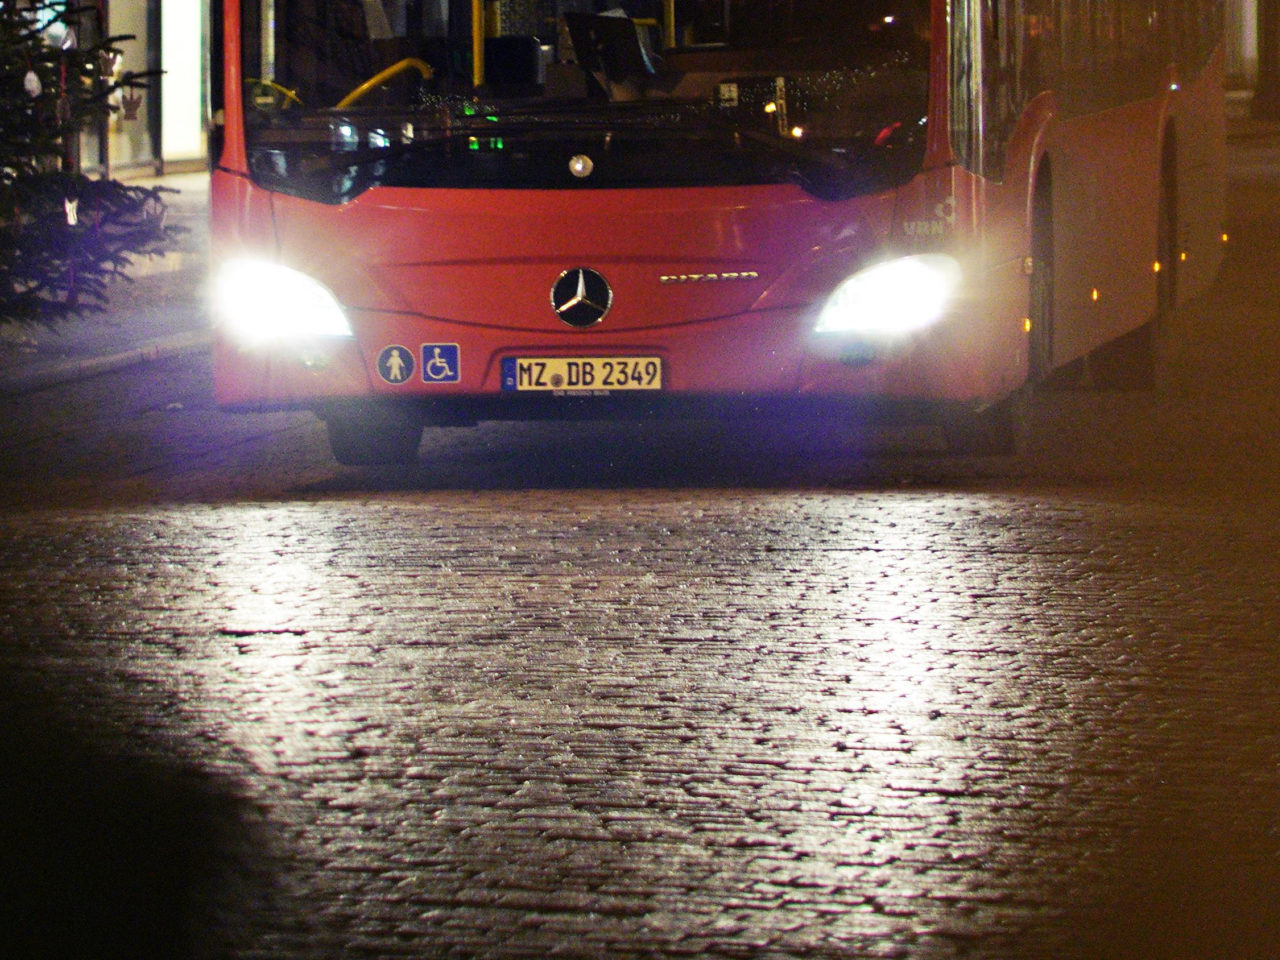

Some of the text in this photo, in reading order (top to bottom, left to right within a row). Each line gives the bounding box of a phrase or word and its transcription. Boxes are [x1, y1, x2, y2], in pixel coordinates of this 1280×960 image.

[518, 362, 658, 387] MZ DB 2349
